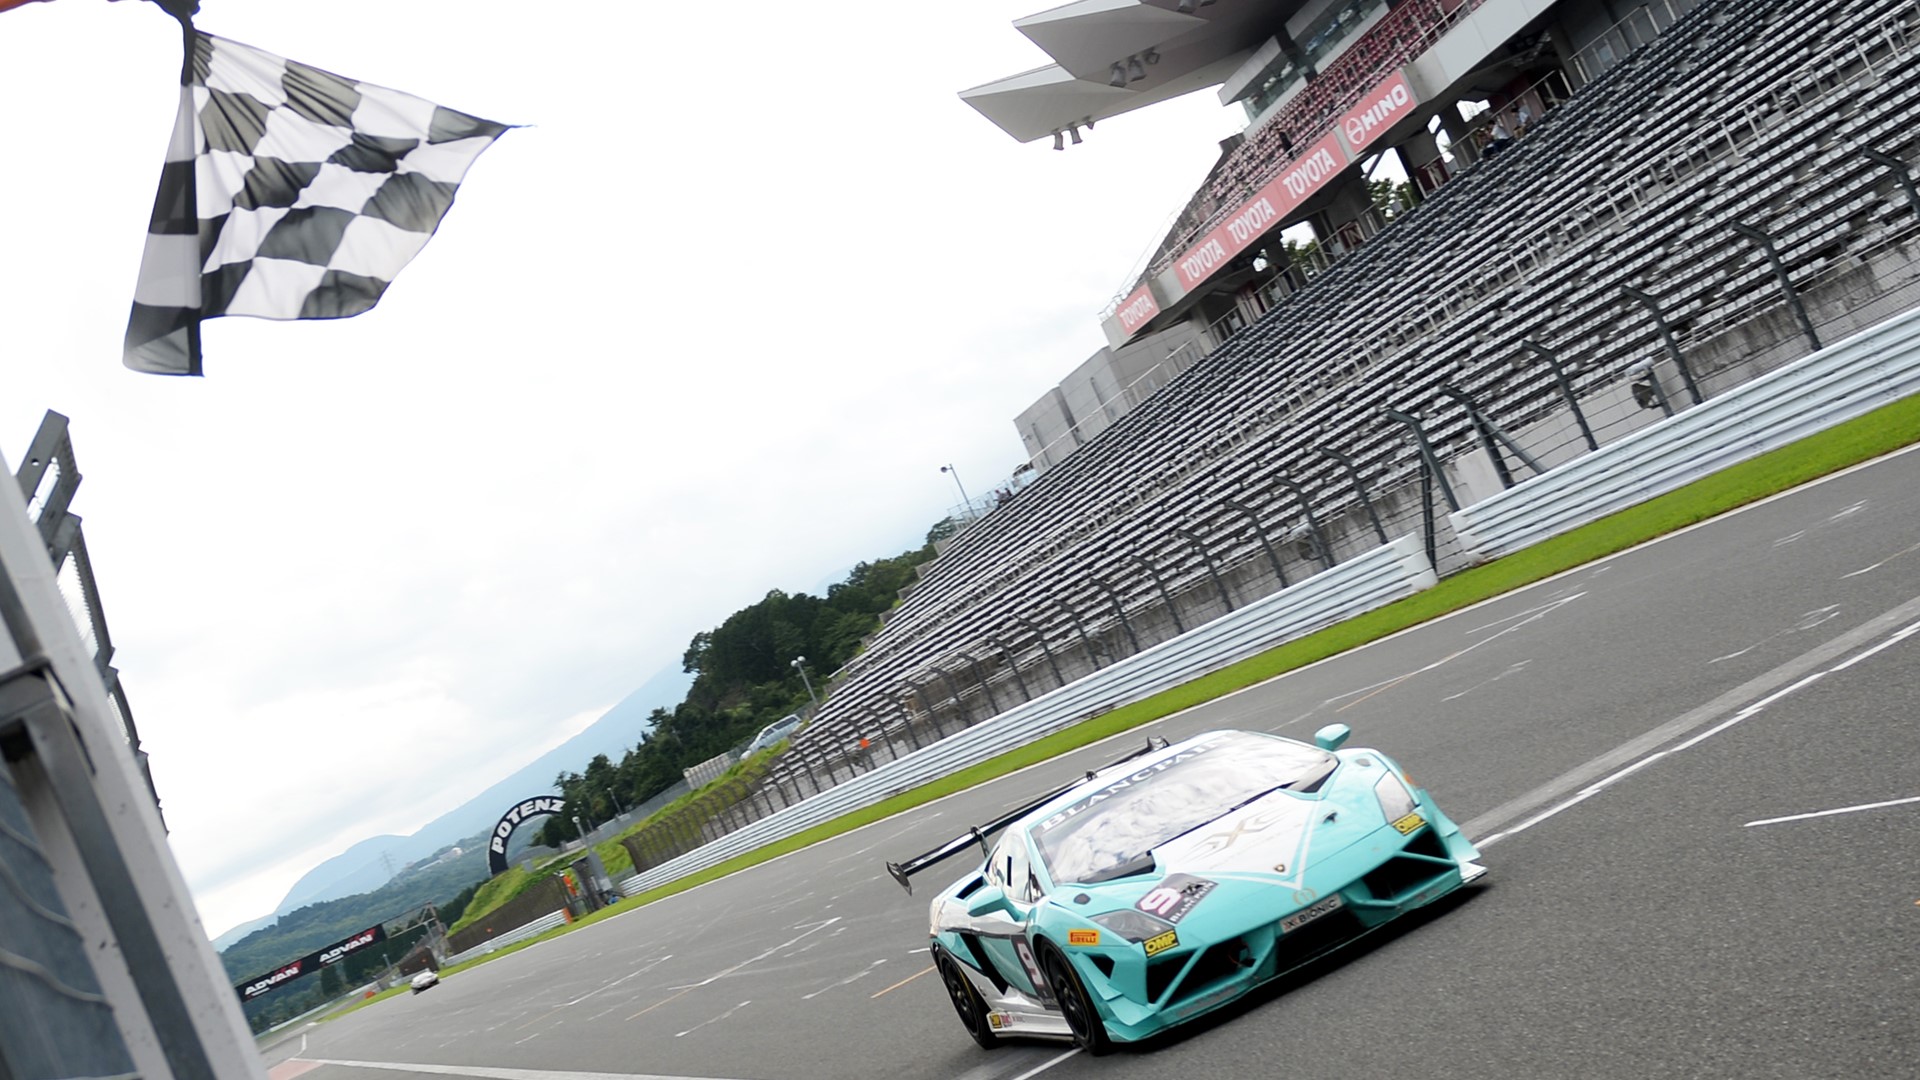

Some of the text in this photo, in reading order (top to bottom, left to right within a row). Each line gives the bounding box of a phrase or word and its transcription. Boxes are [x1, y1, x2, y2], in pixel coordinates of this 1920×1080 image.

[1360, 84, 1408, 131] HINO
[1282, 148, 1337, 199] TOYOTA
[1227, 197, 1276, 244] TOYOTA
[1181, 238, 1226, 282] TOYOTA
[1119, 294, 1154, 328] TOYOTA
[1396, 814, 1421, 832] OMP
[1140, 887, 1182, 915] 9
[319, 934, 373, 963] ADVAN
[1145, 933, 1176, 953] OMP
[244, 966, 300, 995] ADVAN
[1017, 942, 1045, 986] 9
